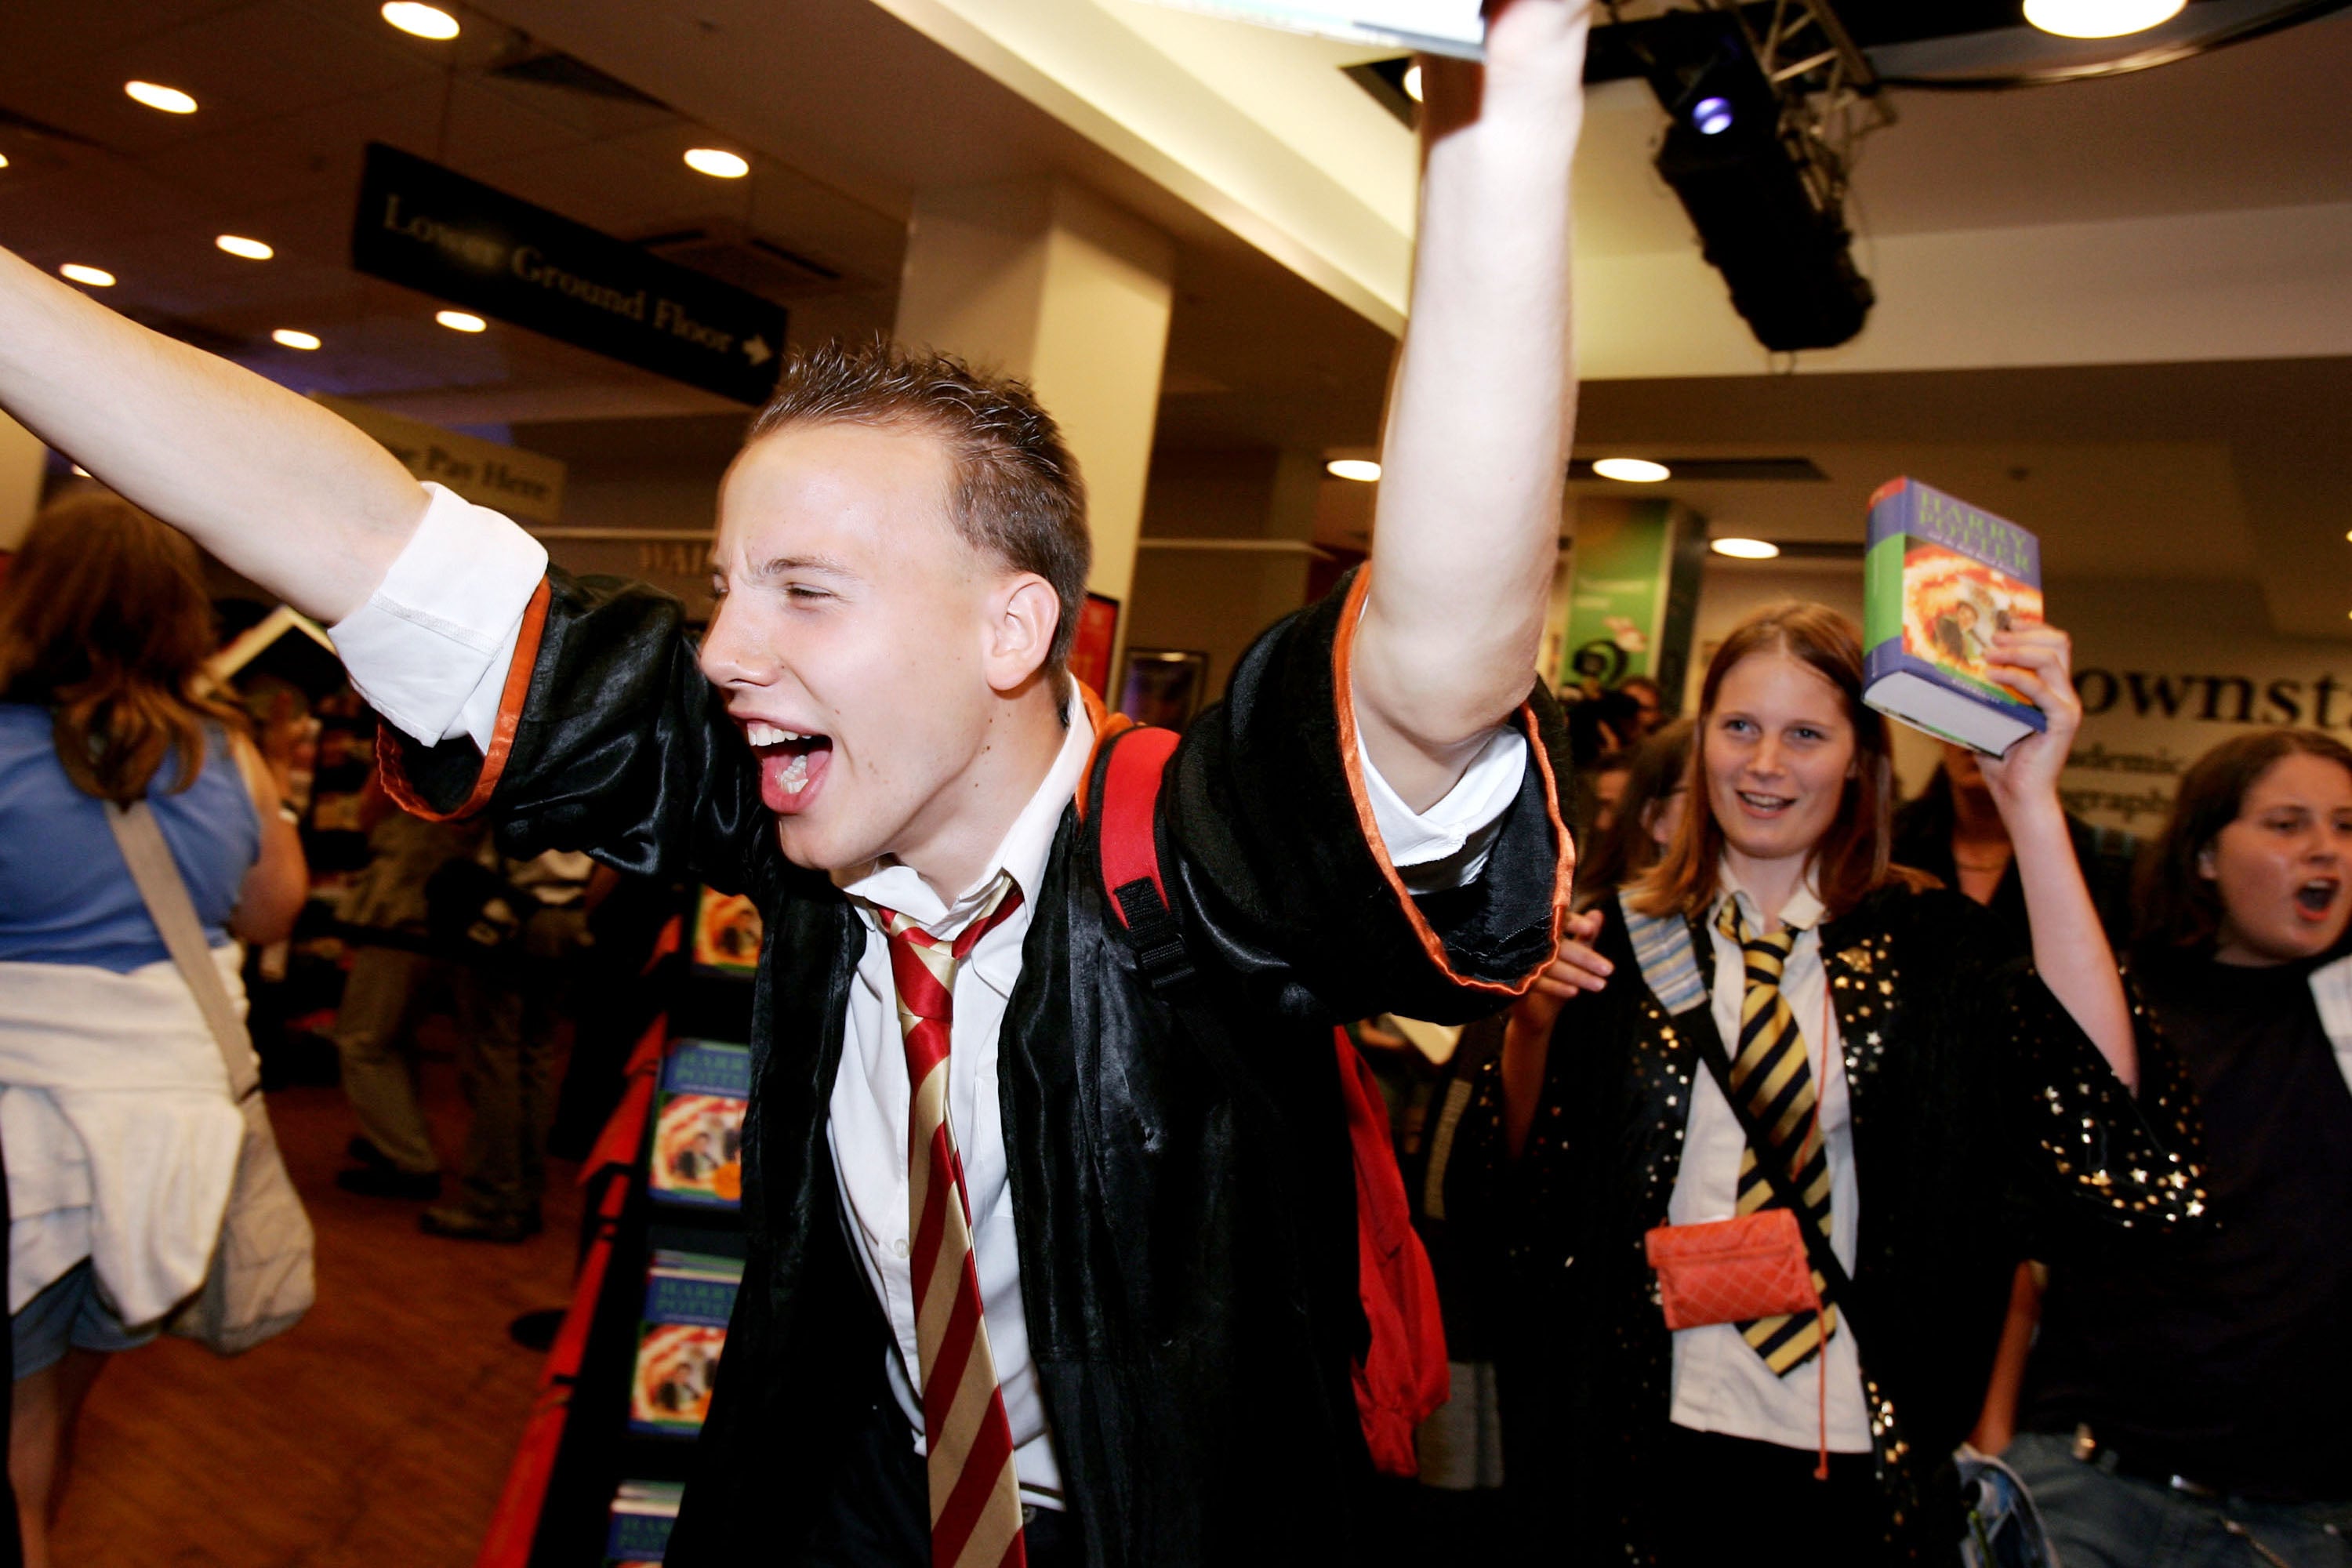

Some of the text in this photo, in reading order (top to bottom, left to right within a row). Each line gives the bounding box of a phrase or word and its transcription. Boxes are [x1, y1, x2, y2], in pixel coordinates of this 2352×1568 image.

[383, 194, 735, 353] Lower Ground Floor
[1918, 508, 2034, 575] POTTER
[1921, 491, 2027, 552] HARRY
[2072, 668, 2352, 729] ownst
